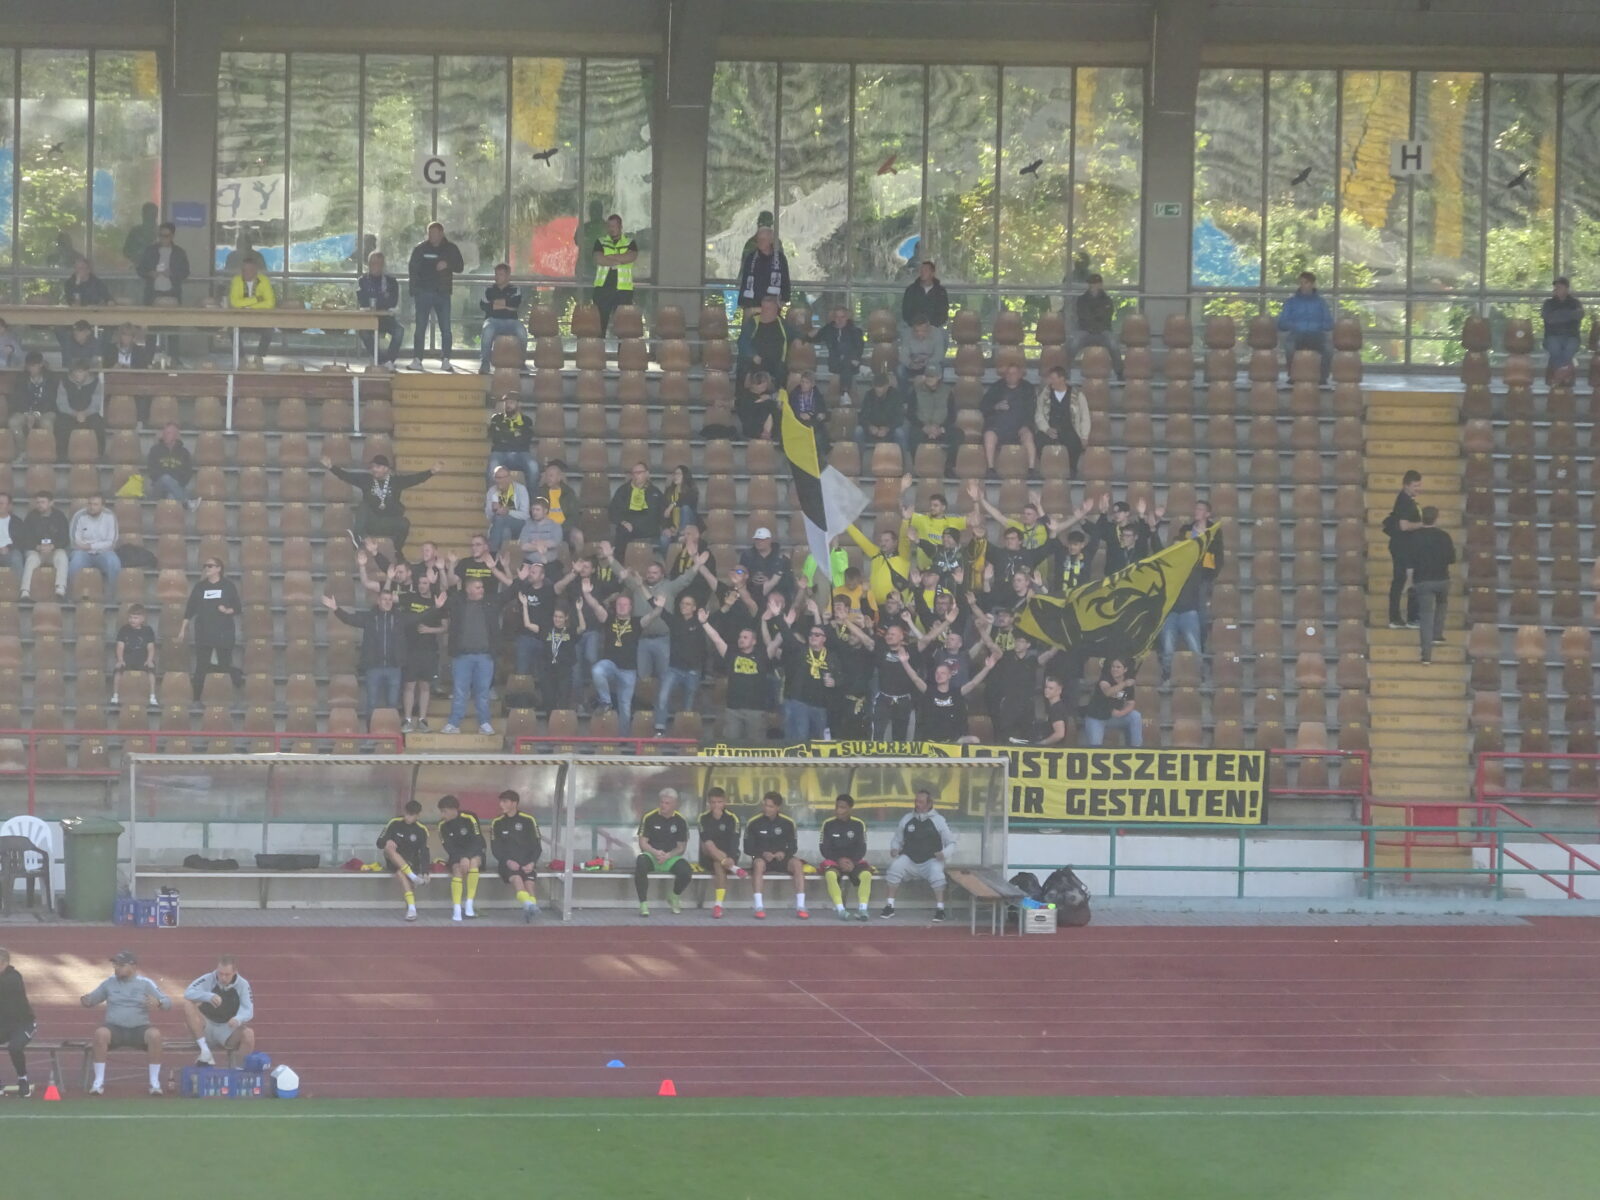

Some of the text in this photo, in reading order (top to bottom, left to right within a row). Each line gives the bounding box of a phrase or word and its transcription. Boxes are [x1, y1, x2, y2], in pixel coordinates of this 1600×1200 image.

[1402, 145, 1421, 170] H
[424, 158, 446, 184] G
[841, 740, 924, 756] SUPCREW
[1065, 787, 1260, 818] GESTALTEN!
